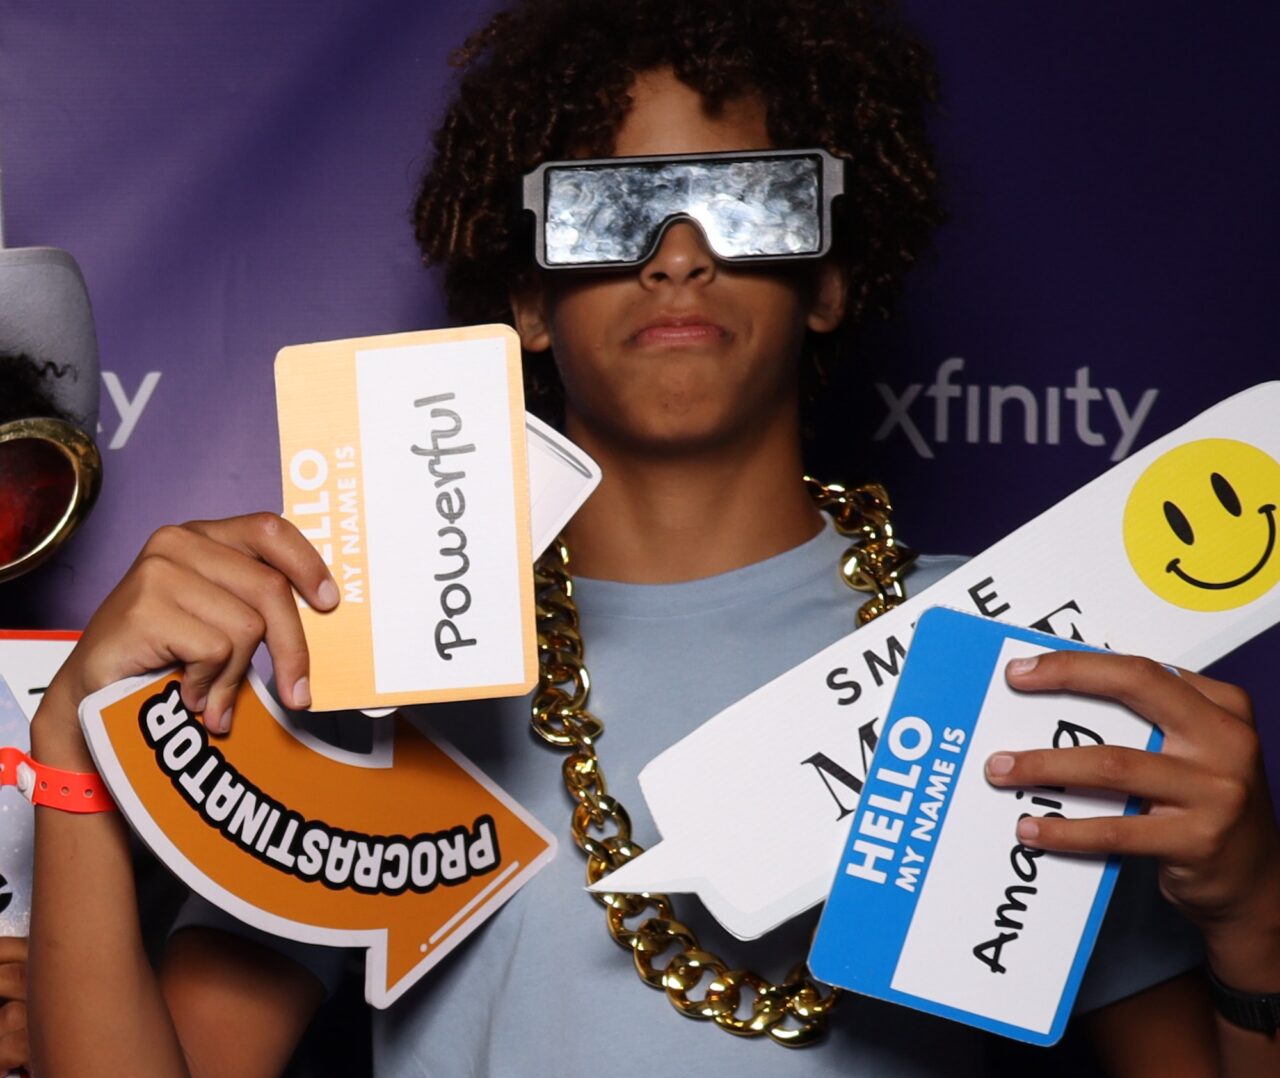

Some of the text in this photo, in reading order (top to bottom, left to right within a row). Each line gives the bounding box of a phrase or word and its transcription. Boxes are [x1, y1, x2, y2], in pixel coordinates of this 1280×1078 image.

[873, 357, 1159, 461] xfinity
[289, 449, 334, 608] LLO
[336, 445, 365, 604] MY NAME IS
[411, 392, 477, 660] Powerful
[826, 577, 1010, 706] SME
[146, 689, 497, 889] PROCRASTINATOR
[846, 715, 933, 885] HELLO
[895, 726, 966, 893] MY NAME IS
